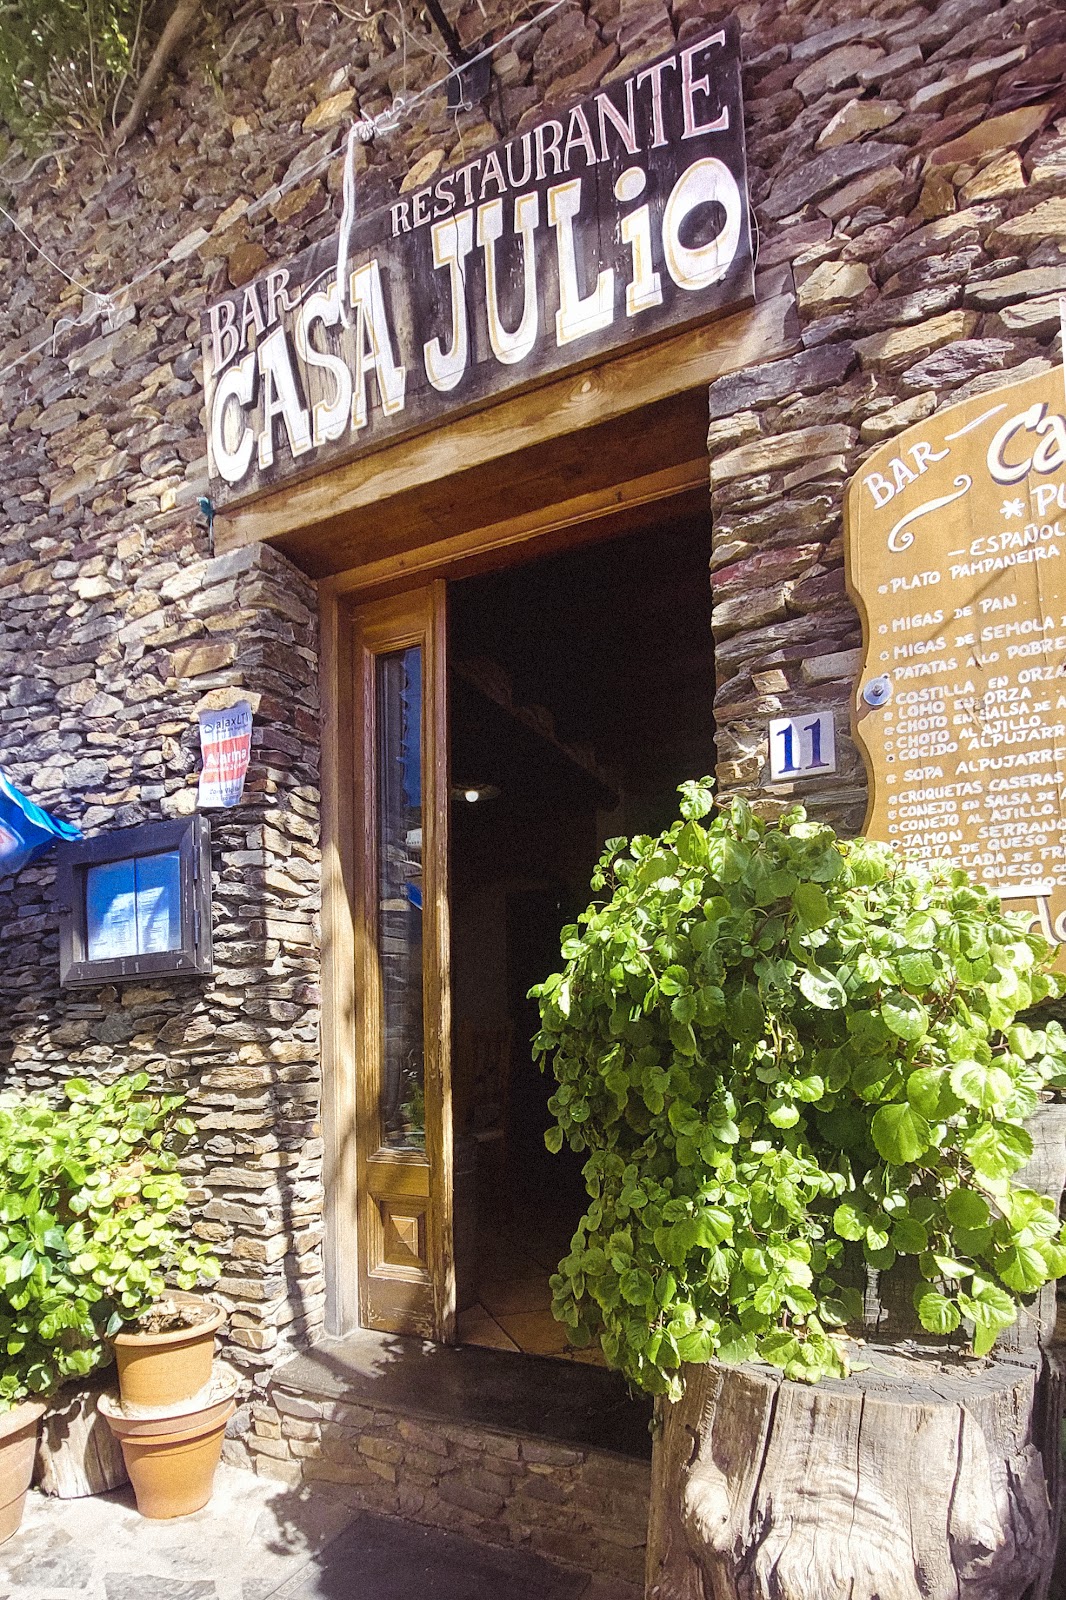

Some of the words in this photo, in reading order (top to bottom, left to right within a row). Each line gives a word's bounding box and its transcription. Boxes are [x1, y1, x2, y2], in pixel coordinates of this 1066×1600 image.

[390, 30, 730, 238] RESTAURANTE
[208, 268, 299, 375] BAR
[213, 259, 406, 482] CASA
[862, 441, 950, 510] BAR
[890, 571, 941, 593] PLATO
[949, 544, 1060, 580] PAMPANEIRA
[892, 609, 944, 632] MIGAS
[953, 606, 973, 619] DE
[979, 593, 1017, 614] PAN
[893, 636, 947, 660] MIGAS
[954, 633, 975, 648] DE
[981, 615, 1055, 642] SEMOLA
[893, 657, 958, 680] PATATAS
[1006, 635, 1066, 660] POBRE
[895, 680, 976, 705] COSTILLA
[988, 675, 1009, 689] EN
[1018, 662, 1066, 684] ORZA
[982, 686, 1032, 705] ORZA
[896, 715, 948, 734] CHOTO
[979, 701, 1030, 720] SALSA
[1032, 700, 1052, 713] DE
[776, 718, 830, 774] 11
[896, 729, 950, 748] CHOTO
[959, 727, 978, 739] AL
[898, 741, 959, 761] COCIDO
[898, 780, 984, 804] CROQUETAS
[988, 771, 1065, 792] CASERAS
[903, 766, 944, 782] SOPA
[898, 800, 957, 818] CONEJO
[961, 800, 980, 811] EN
[983, 792, 1032, 808] SALSA
[1035, 790, 1057, 803] DE
[899, 813, 959, 831] CONEJO
[966, 813, 985, 824] AL
[902, 829, 963, 847] JAMON
[977, 818, 1066, 838] SERRANO
[903, 844, 953, 861] TARTA
[958, 842, 980, 854] DE
[987, 834, 1048, 851] QUESO
[1011, 851, 1033, 863] DE
[982, 862, 1044, 879] QUESO
